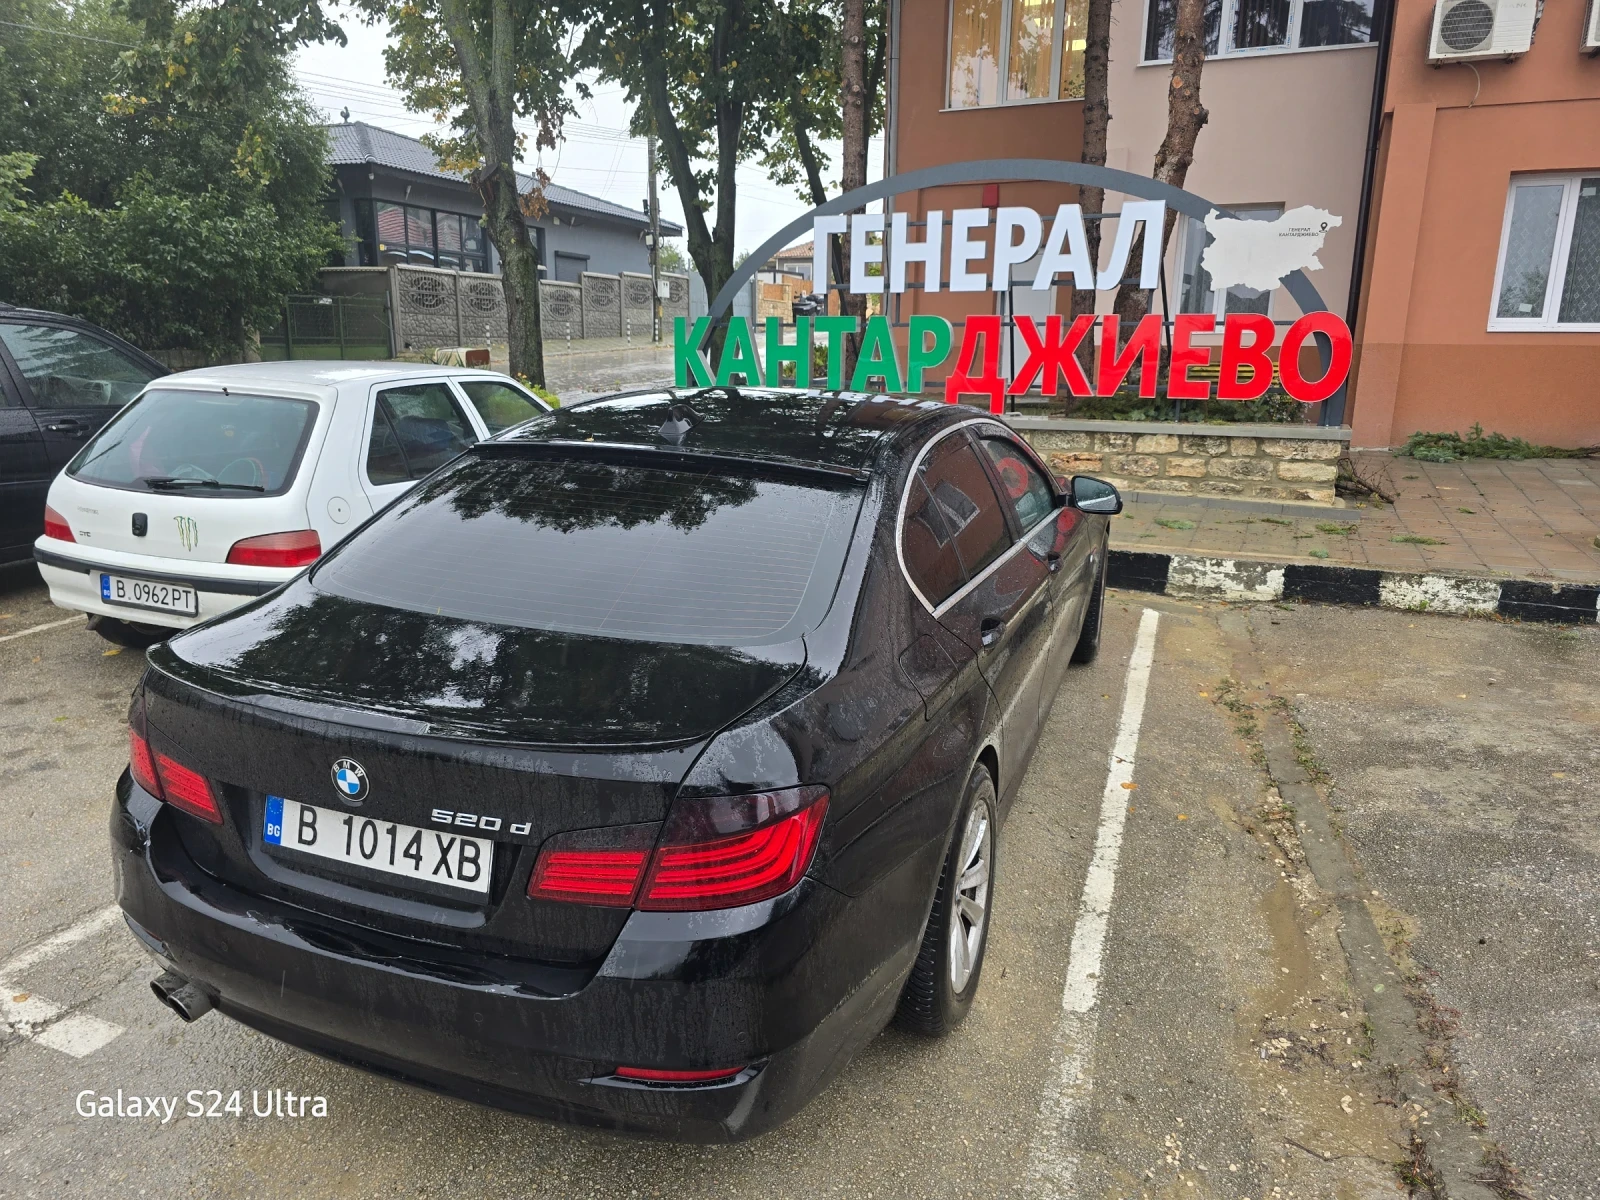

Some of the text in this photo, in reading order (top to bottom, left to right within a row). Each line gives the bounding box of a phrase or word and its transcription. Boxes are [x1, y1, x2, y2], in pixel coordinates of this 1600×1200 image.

[812, 200, 1167, 292] ГЕНЕРАЛ
[673, 311, 1353, 415] КАНТАРДЖИЕВО
[331, 760, 364, 778] BMW
[266, 822, 281, 838] BG
